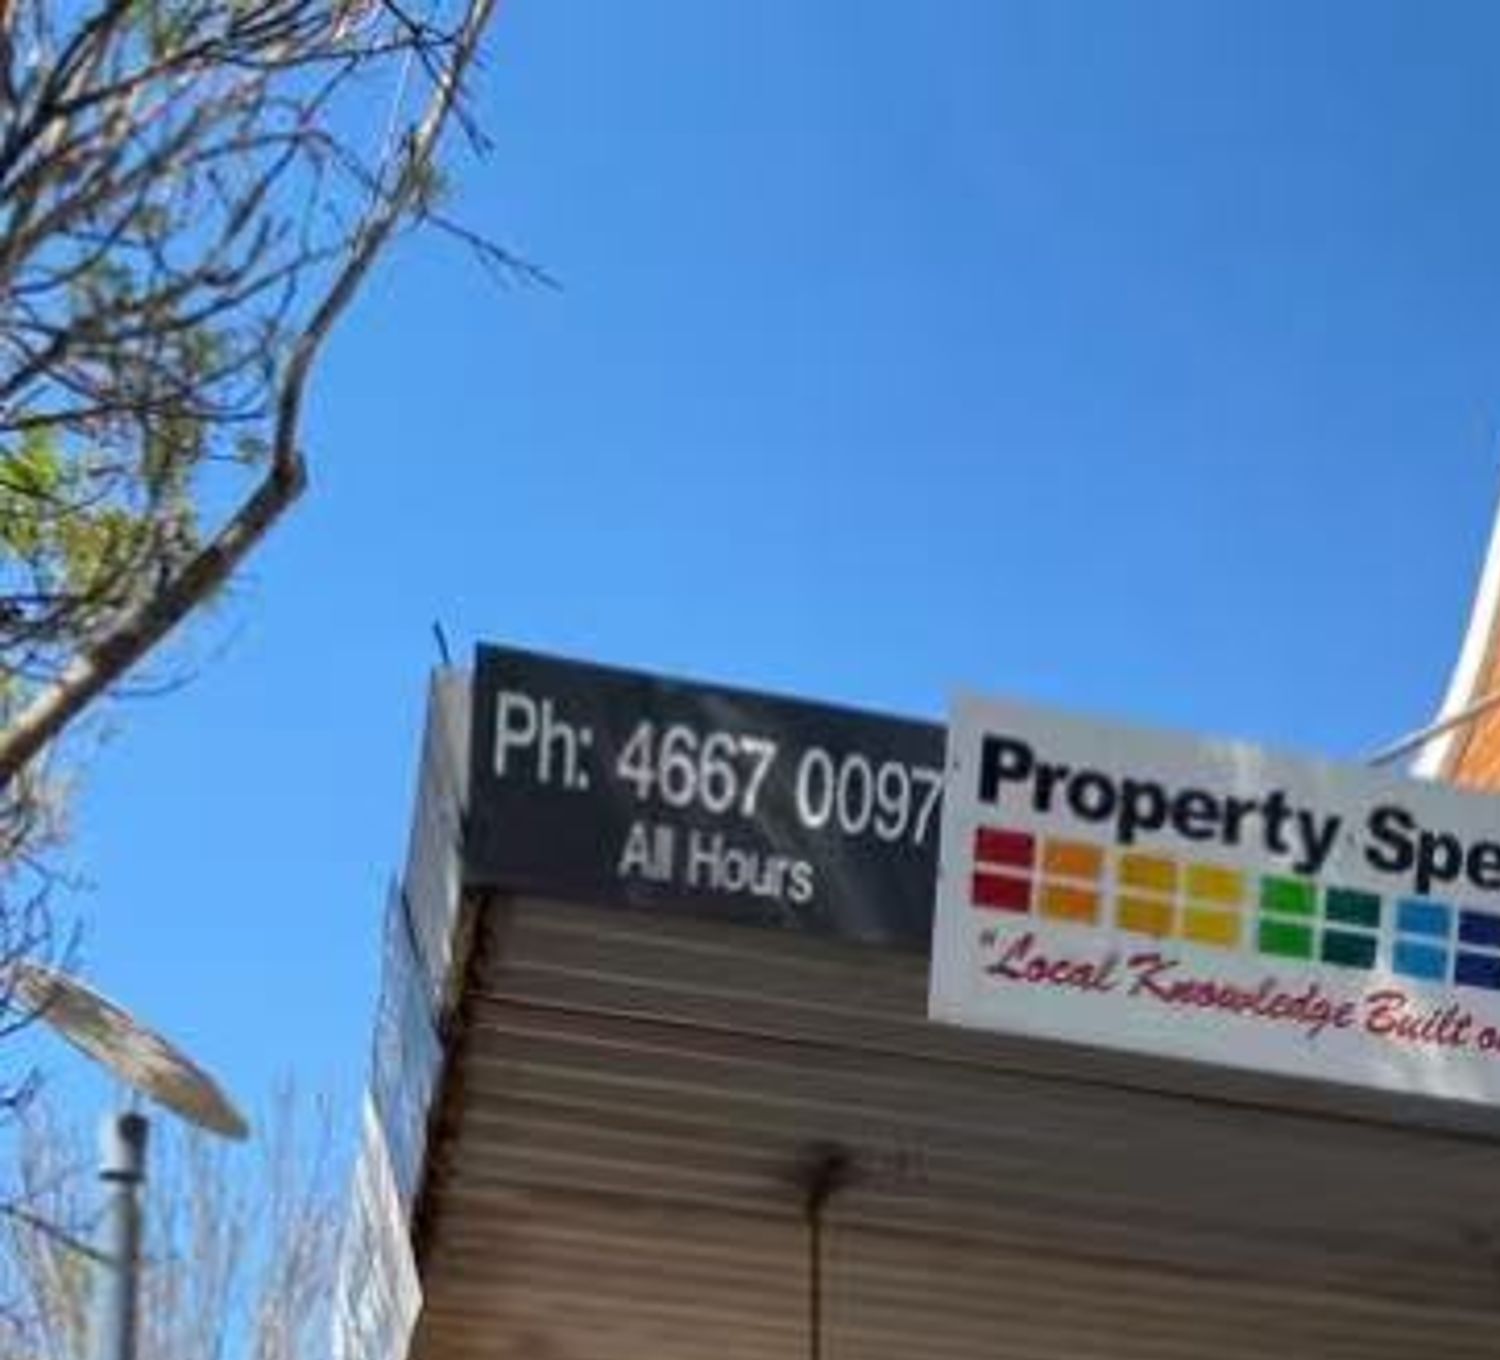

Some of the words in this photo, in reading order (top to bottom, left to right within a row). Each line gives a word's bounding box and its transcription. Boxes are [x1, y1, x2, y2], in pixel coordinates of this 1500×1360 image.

[493, 692, 592, 790] Ph:
[616, 720, 778, 817] 4667
[798, 747, 944, 846] 0097
[977, 734, 1340, 874] Property
[617, 820, 672, 882] All
[687, 831, 814, 904] Hours
[1127, 953, 1357, 1038] Knowledge
[1366, 990, 1473, 1048] Built
